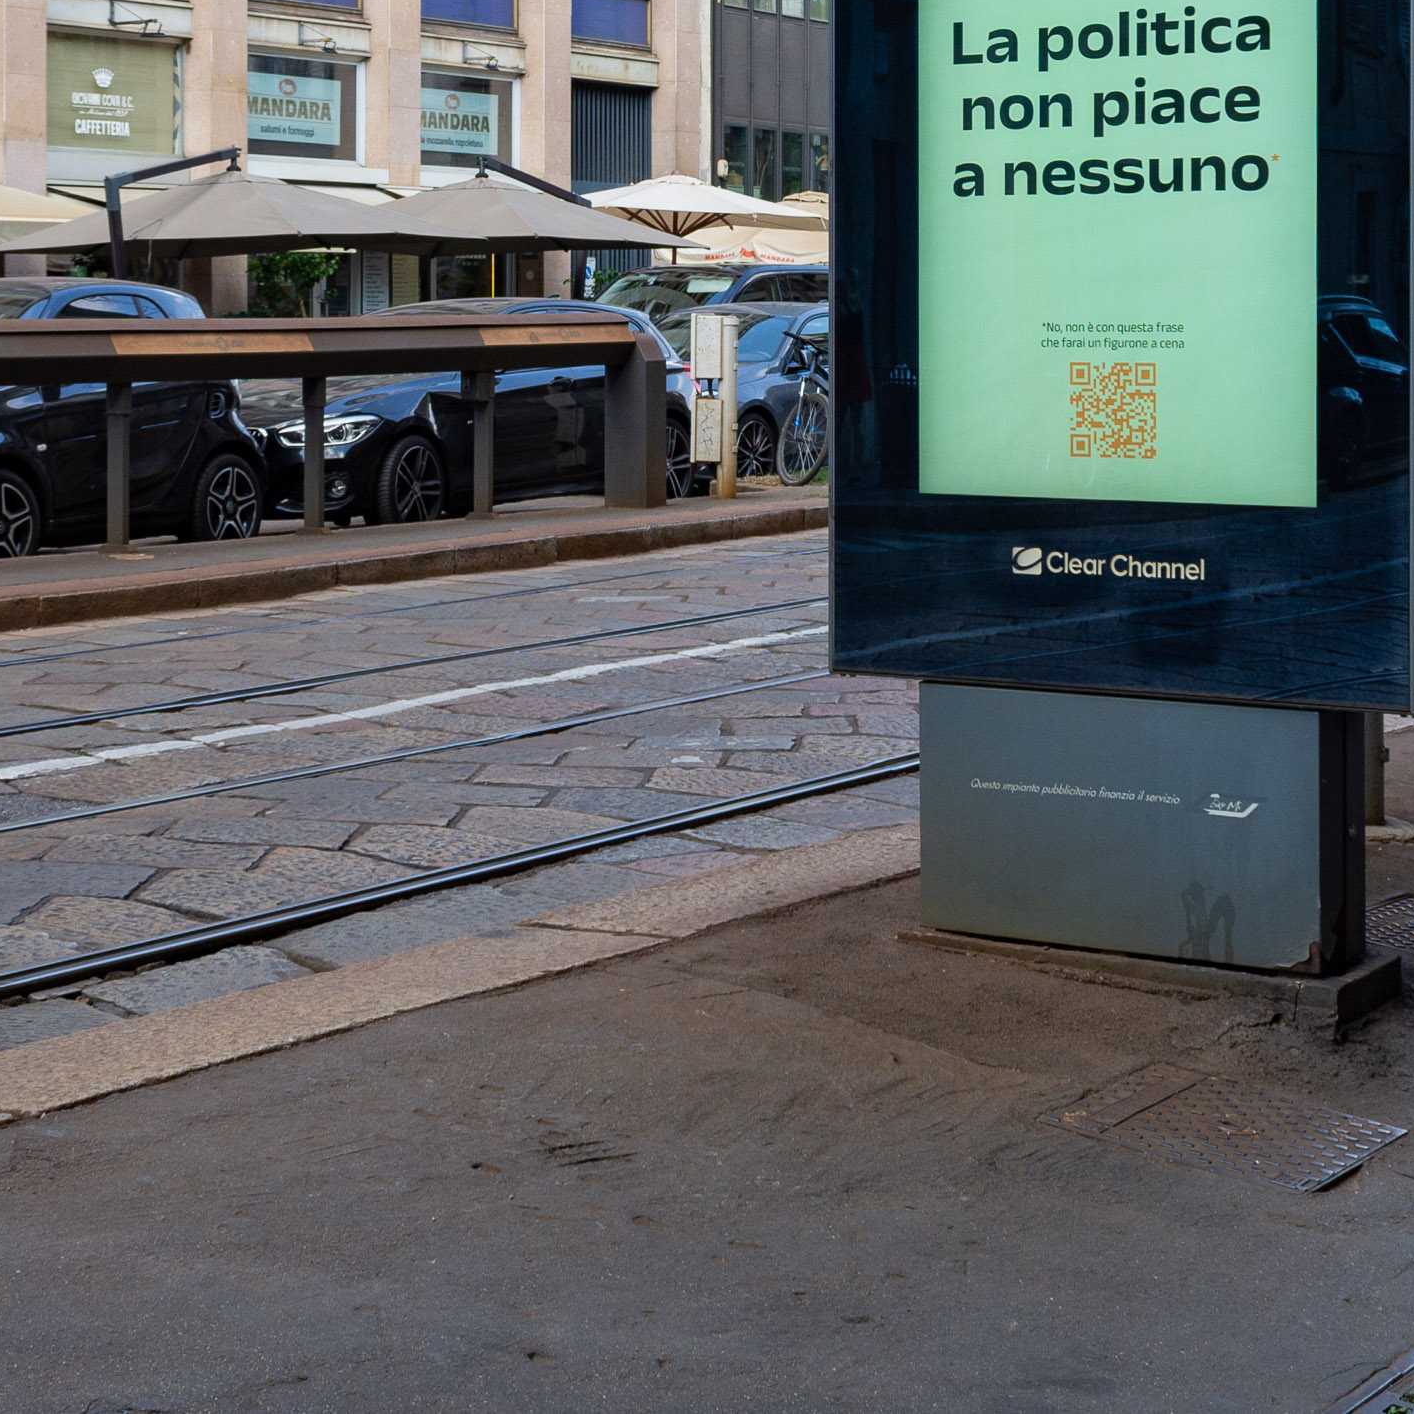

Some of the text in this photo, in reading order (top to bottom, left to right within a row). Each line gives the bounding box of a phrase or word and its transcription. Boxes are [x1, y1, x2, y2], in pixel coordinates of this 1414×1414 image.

[953, 6, 1271, 72] La politica
[247, 96, 331, 121] MANDARA
[962, 77, 1261, 137] non piace
[74, 119, 131, 137] CAFFETTERIA
[953, 162, 985, 197] a
[1066, 324, 1085, 332] non
[1087, 321, 1094, 333] è
[1096, 324, 1115, 332] con
[1117, 323, 1154, 334] questa
[1156, 322, 1185, 333] frase
[1041, 337, 1185, 351] che farai un figurone a cena
[1046, 551, 1205, 581] Clear Channel
[970, 777, 1181, 805] Questo impianto pubblicitario finanzia il servizio
